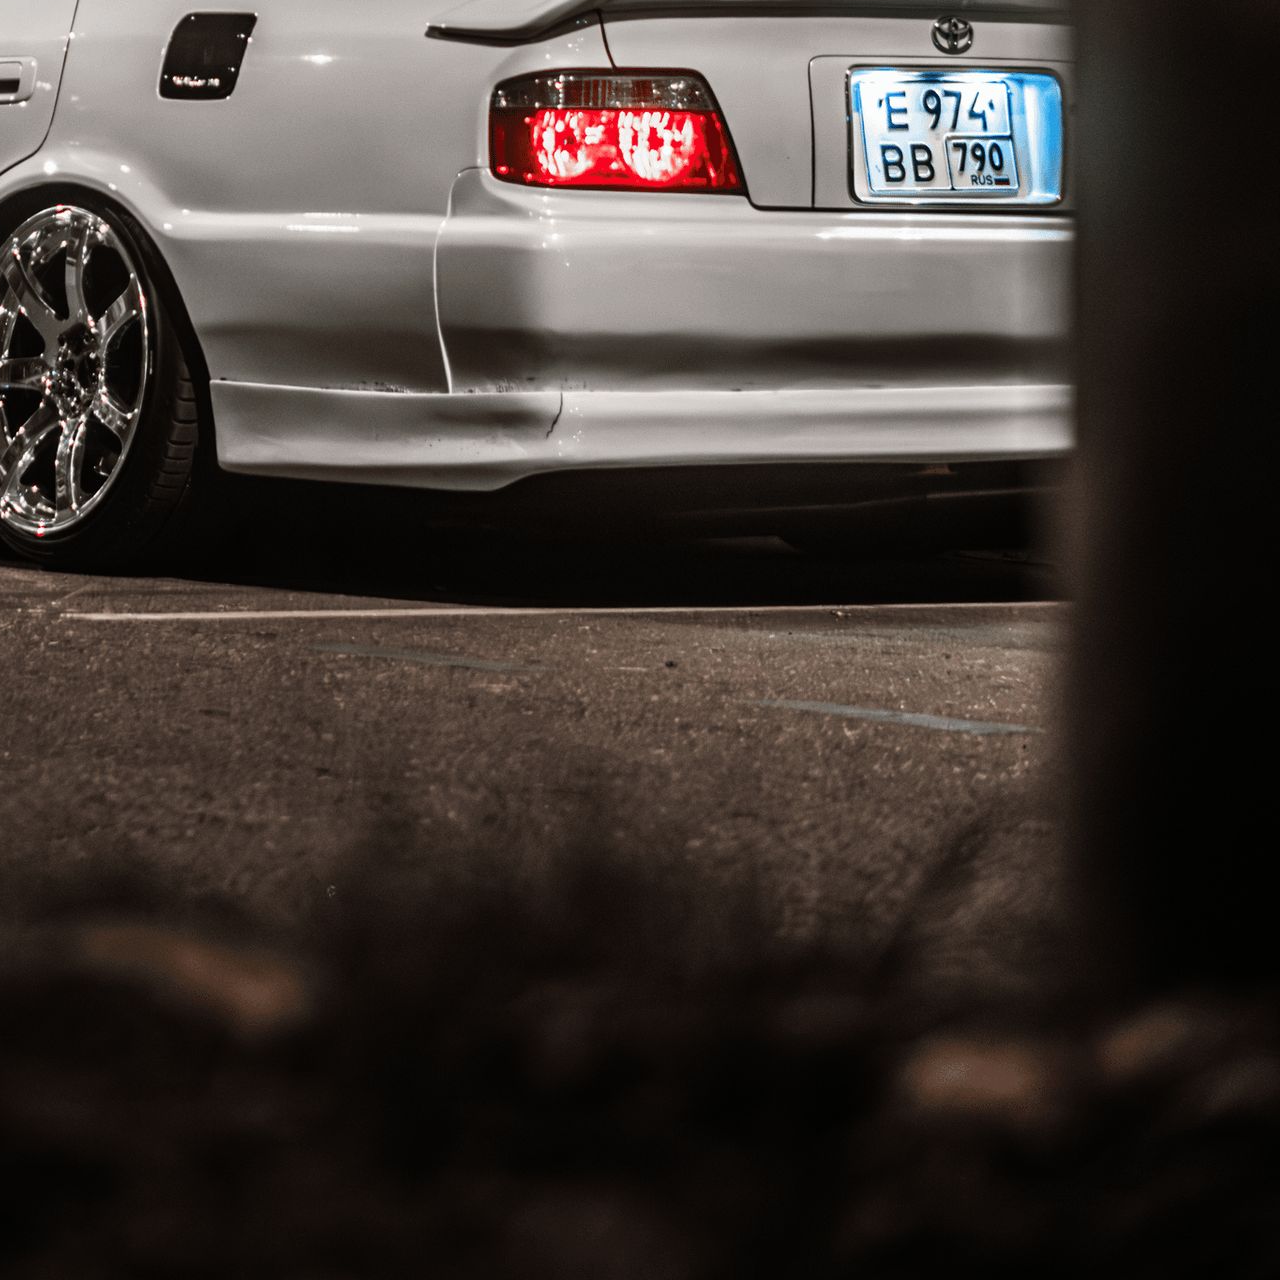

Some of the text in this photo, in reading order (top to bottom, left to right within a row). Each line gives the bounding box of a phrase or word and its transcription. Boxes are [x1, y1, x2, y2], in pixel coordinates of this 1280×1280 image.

[880, 142, 1004, 183] BB 790
[971, 175, 993, 186] RUS
